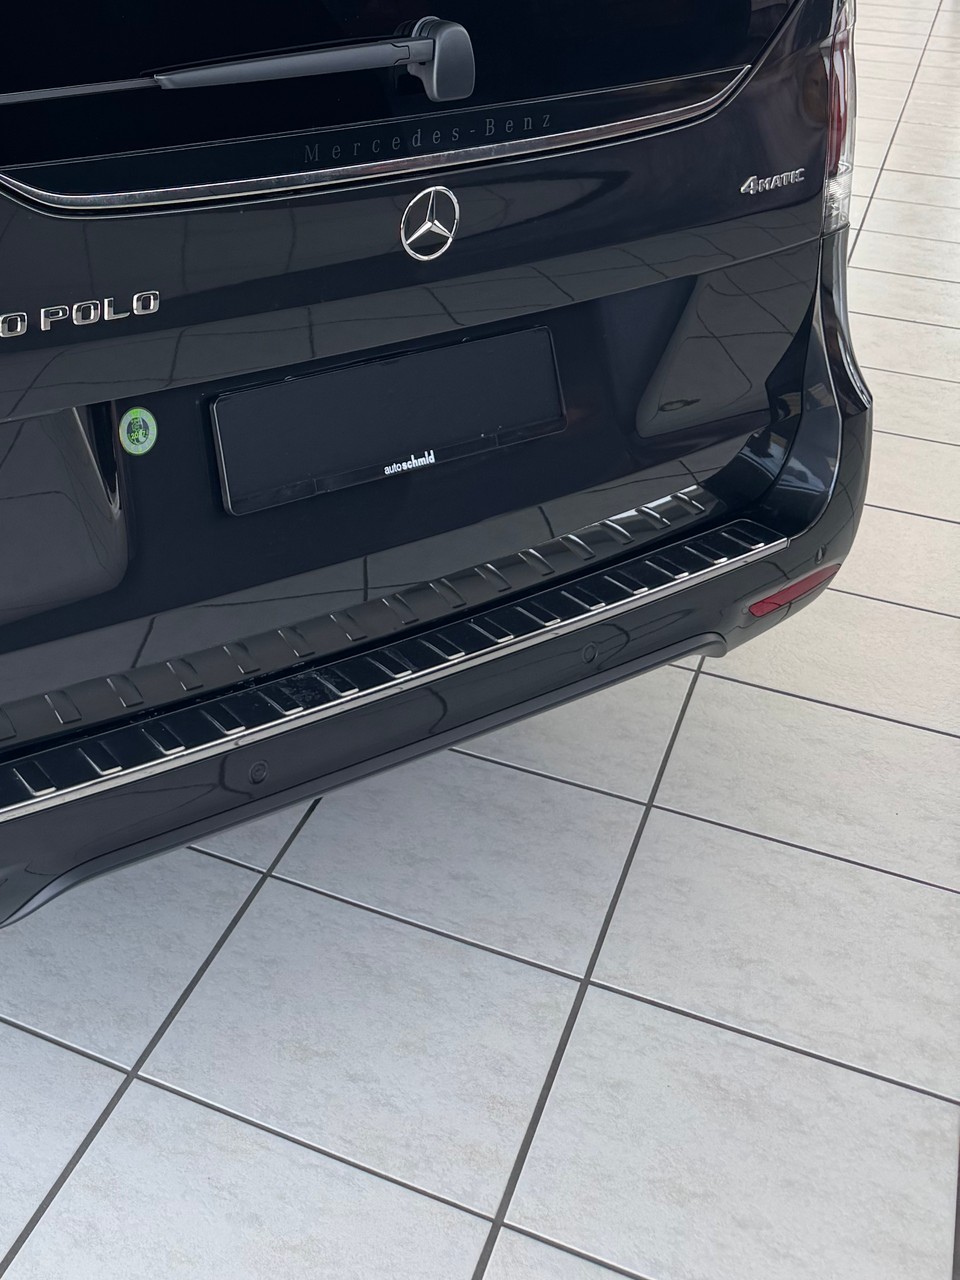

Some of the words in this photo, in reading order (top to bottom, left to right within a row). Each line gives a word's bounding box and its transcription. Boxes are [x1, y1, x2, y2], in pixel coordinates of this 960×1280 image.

[304, 114, 552, 163] Mercedes-Benz
[740, 168, 806, 195] 4MATIC
[40, 290, 160, 331] POLO
